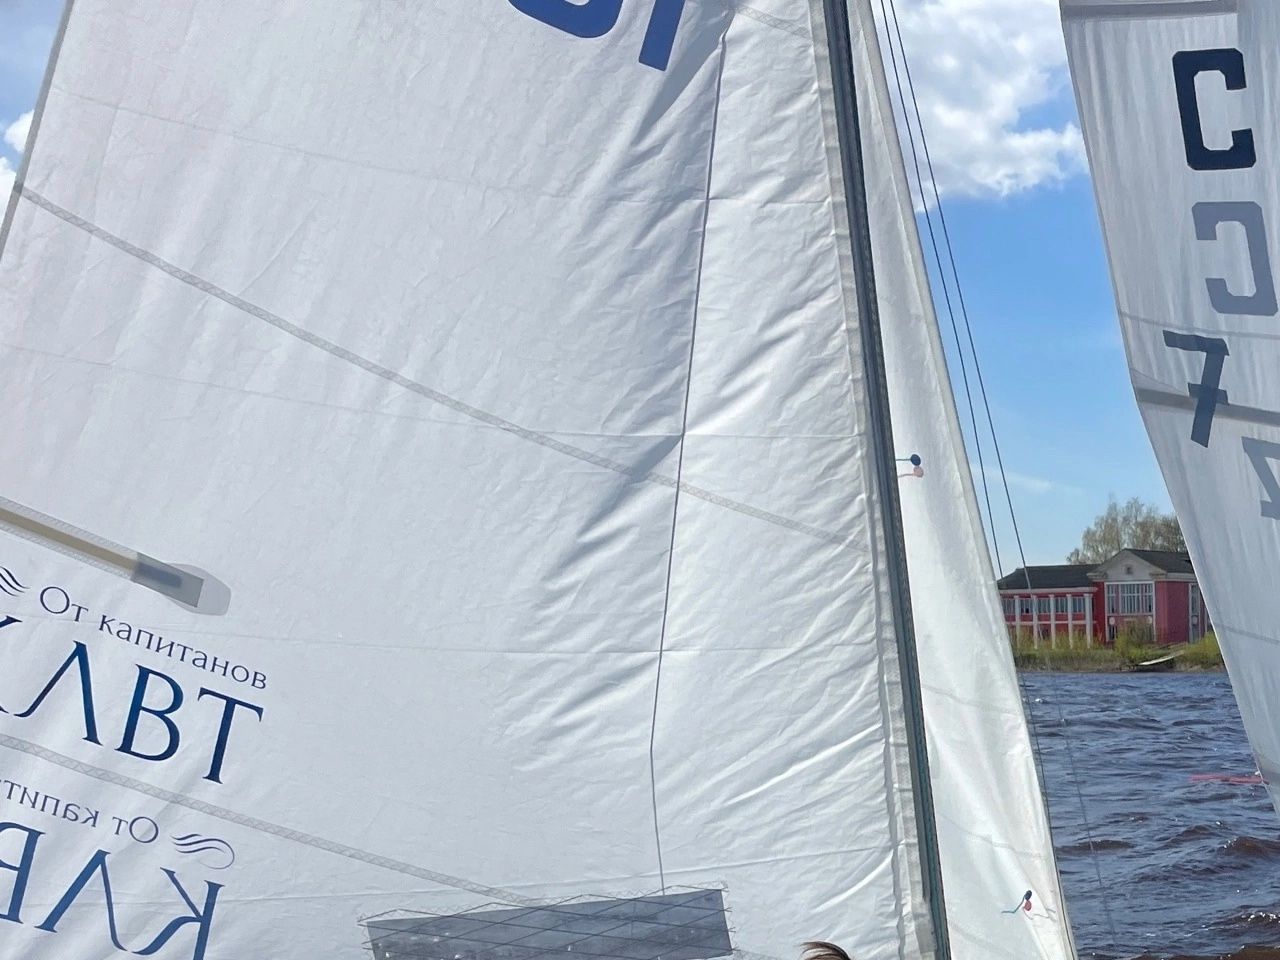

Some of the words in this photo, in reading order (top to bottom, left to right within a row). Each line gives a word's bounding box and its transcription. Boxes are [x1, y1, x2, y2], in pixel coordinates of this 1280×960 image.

[1162, 329, 1230, 448] 7
[39, 585, 89, 624] От
[98, 613, 268, 690] капитанов
